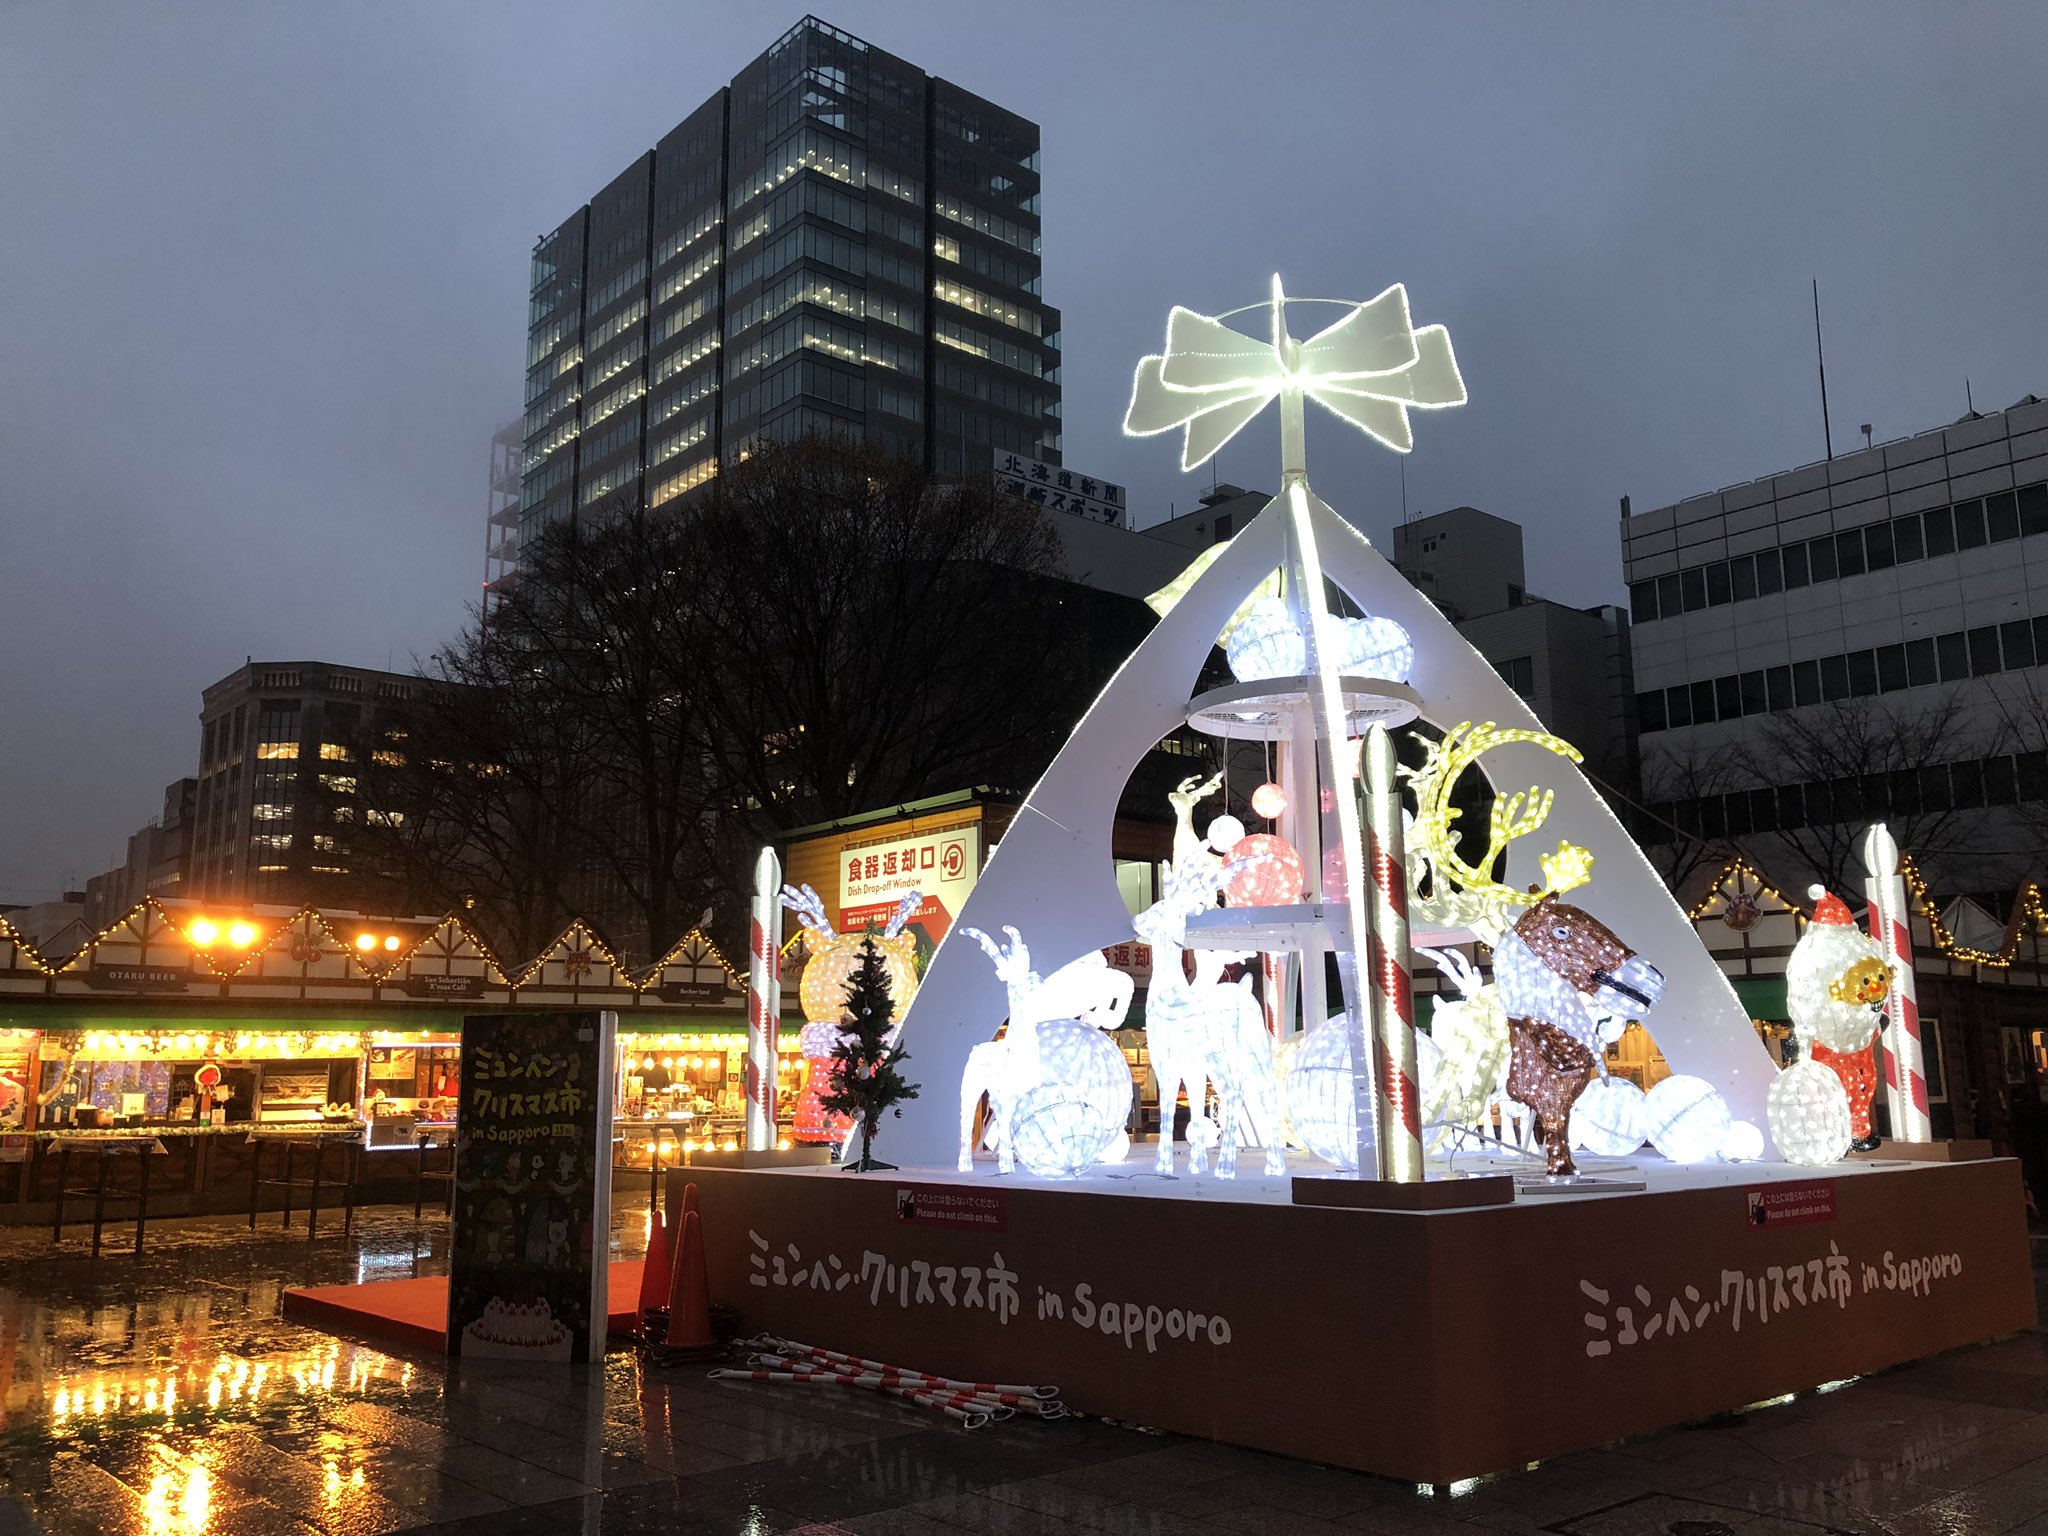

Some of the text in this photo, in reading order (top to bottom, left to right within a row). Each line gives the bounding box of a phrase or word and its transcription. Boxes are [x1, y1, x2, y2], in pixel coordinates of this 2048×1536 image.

[1005, 455, 1118, 503] 北海道新聞
[848, 846, 935, 882] 食器返却口
[848, 877, 922, 897] Dish Drop-off Window
[109, 972, 145, 980] OTARU
[473, 1080, 581, 1119] クリスマス市
[472, 1127, 484, 1139] in
[487, 1125, 550, 1145] Sapporo
[917, 1208, 936, 1217] Please
[937, 1210, 945, 1218] do
[946, 1212, 956, 1220] not
[957, 1212, 974, 1221] climb
[975, 1214, 984, 1222] on
[1860, 1261, 1879, 1294] in
[1882, 1250, 1962, 1297] Sapporo
[1037, 1284, 1064, 1320] in
[1071, 1283, 1232, 1352] Sapporo
